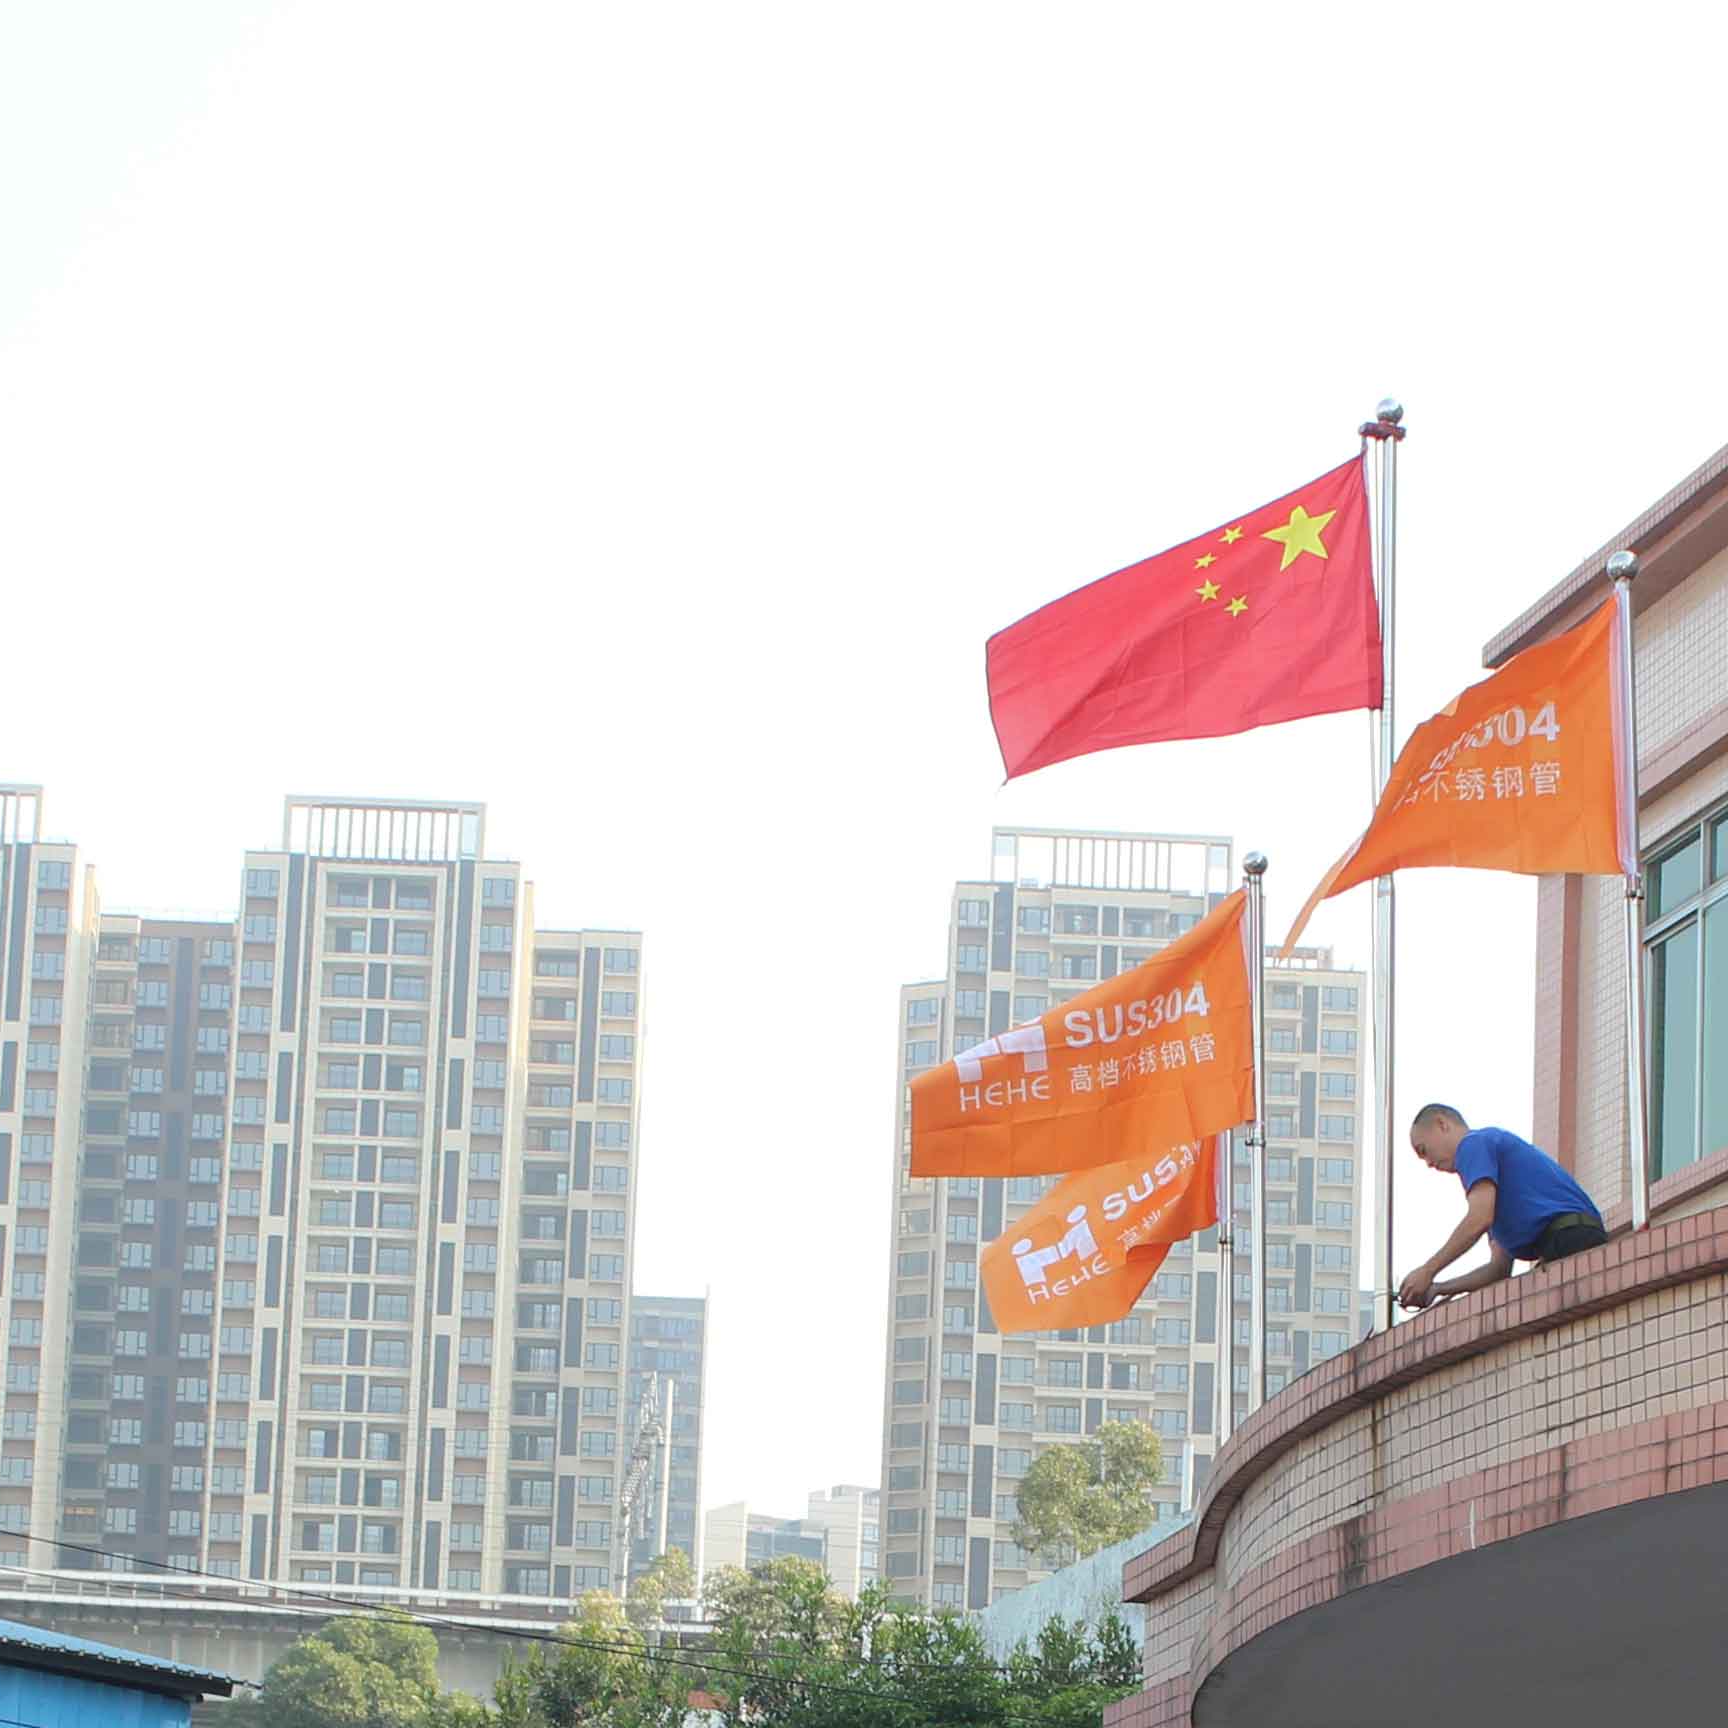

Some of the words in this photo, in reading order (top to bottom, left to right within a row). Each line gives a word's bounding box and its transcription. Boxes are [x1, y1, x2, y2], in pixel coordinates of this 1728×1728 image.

[1064, 980, 1211, 1048] SUS304
[959, 1075, 1052, 1112] HEHE
[1068, 1032, 1216, 1094] 高档不锈钢管
